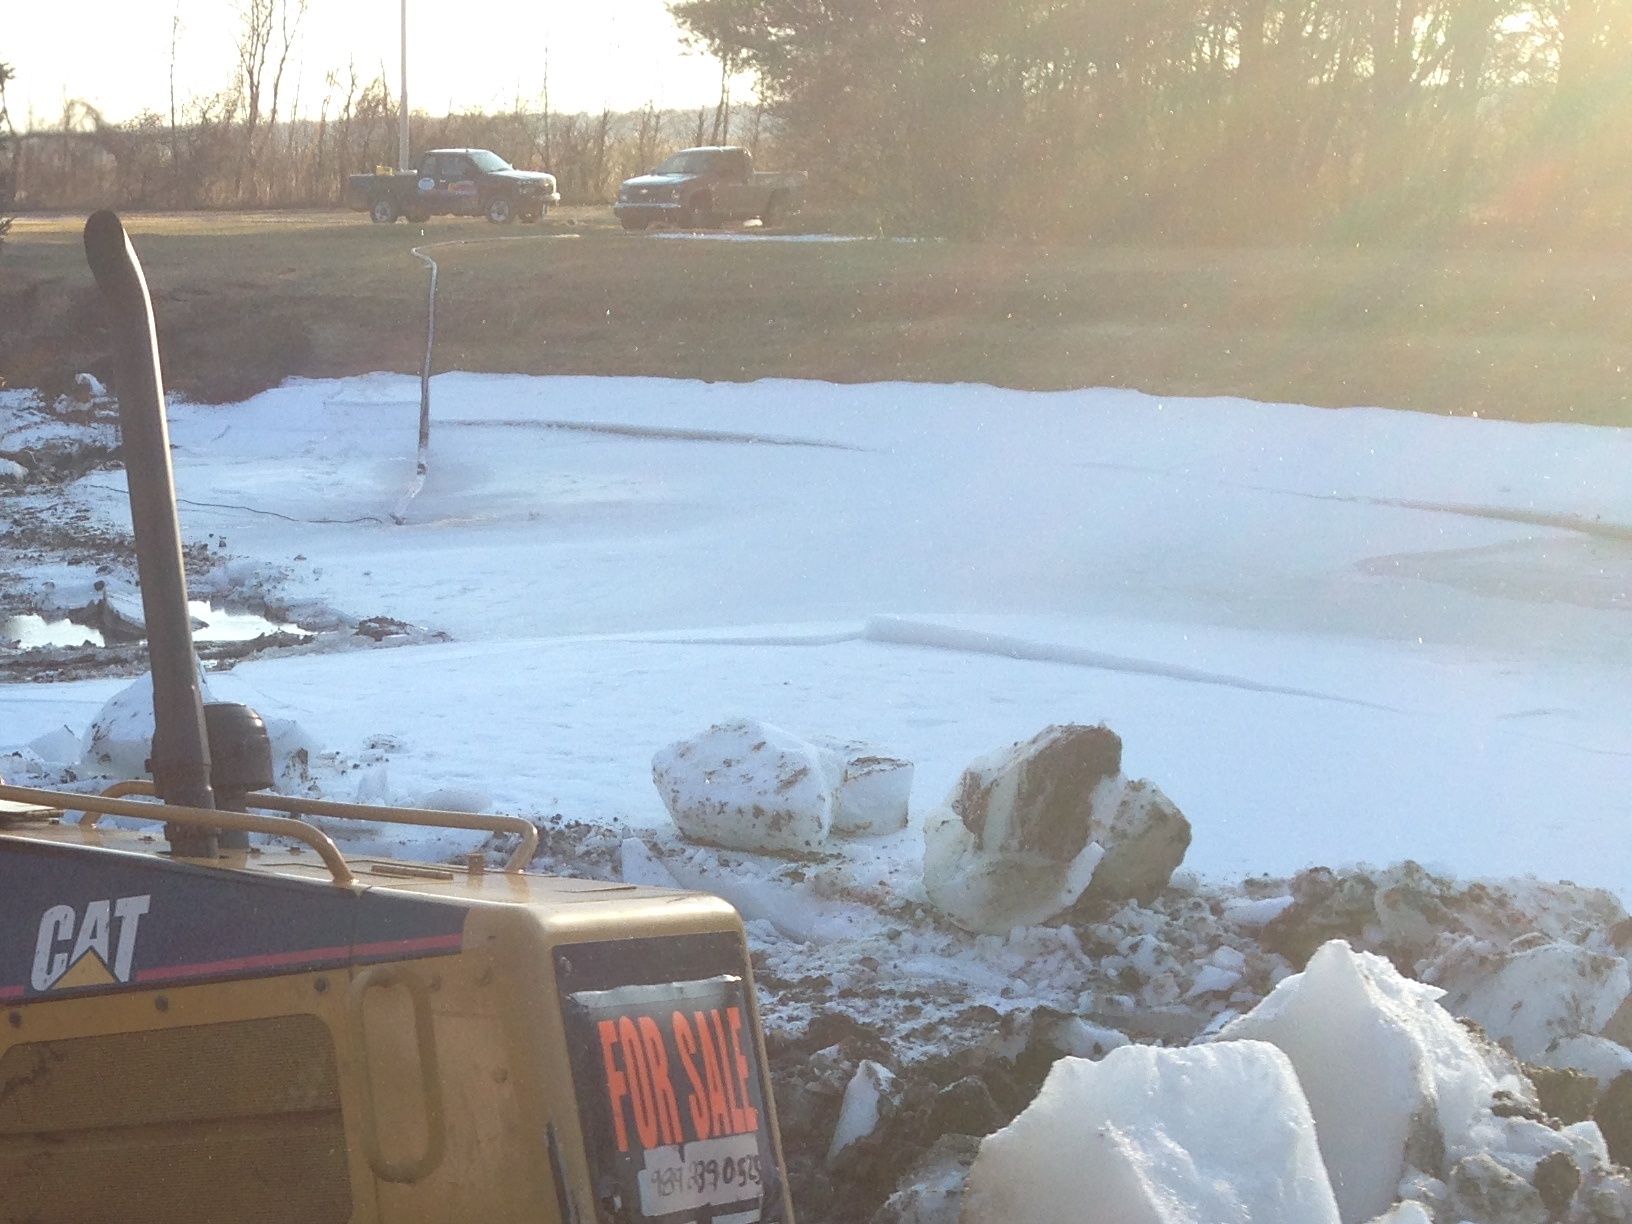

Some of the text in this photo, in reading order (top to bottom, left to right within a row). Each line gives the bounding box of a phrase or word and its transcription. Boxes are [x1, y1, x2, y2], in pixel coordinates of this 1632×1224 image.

[30, 894, 151, 992] CAT
[597, 1007, 759, 1153] FOR SALE
